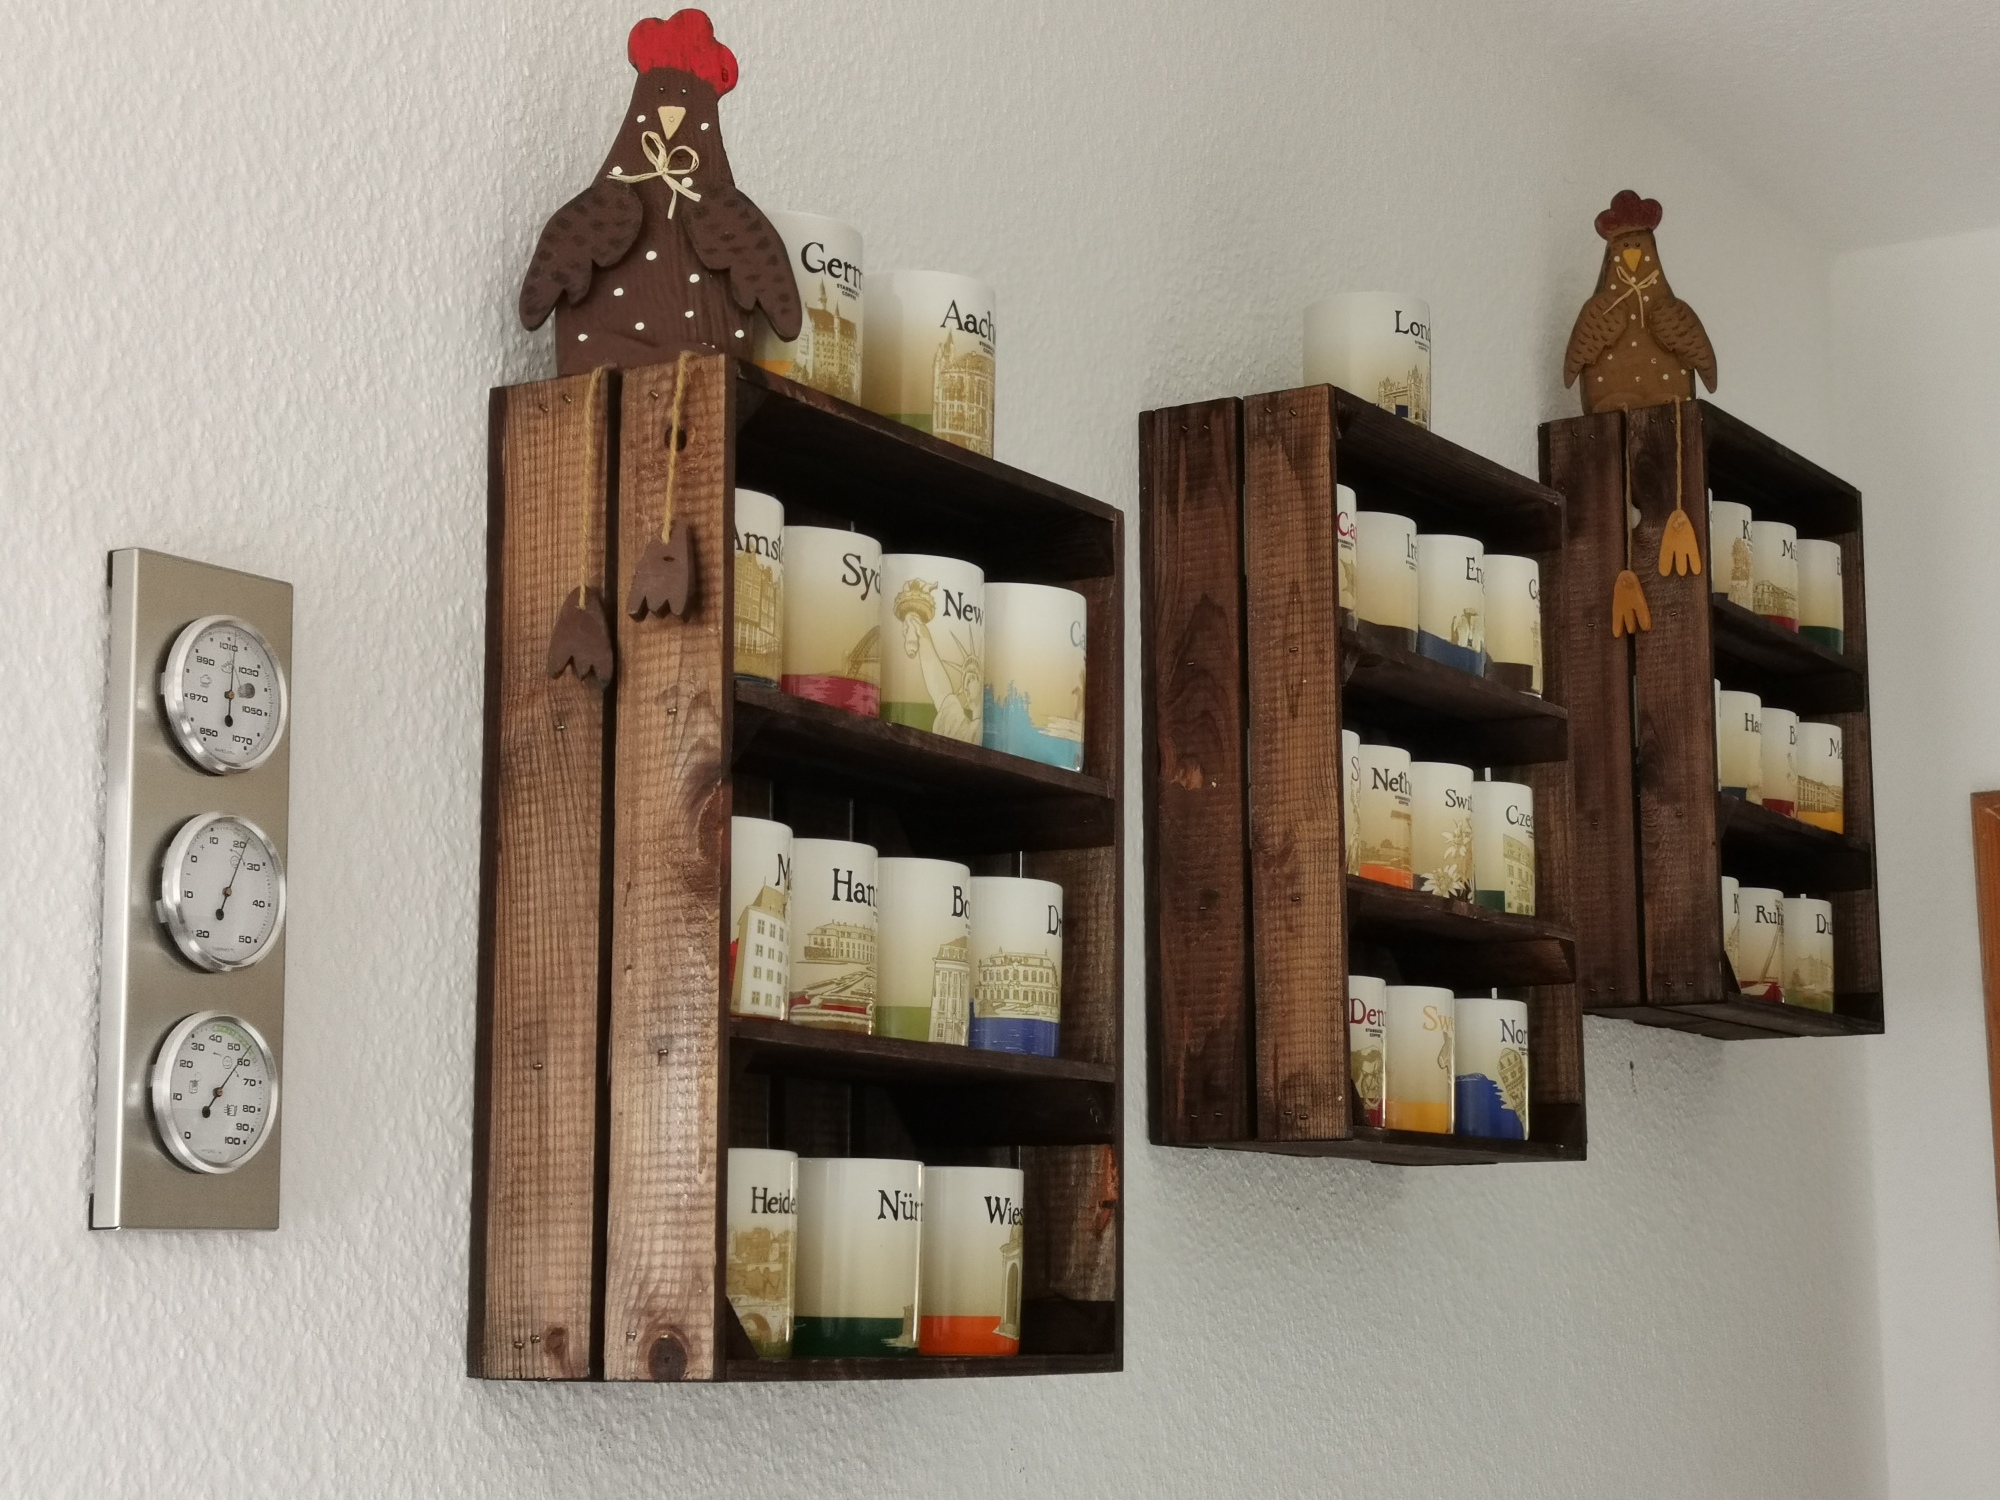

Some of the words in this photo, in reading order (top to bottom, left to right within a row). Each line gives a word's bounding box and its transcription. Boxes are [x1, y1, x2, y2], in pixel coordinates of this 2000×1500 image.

[942, 588, 984, 626] New
[232, 735, 253, 746] 1070
[1371, 767, 1412, 796] Neth
[233, 840, 246, 849] 20
[246, 862, 261, 872] 30
[832, 868, 877, 907] Han
[252, 899, 265, 908] 40
[196, 929, 210, 939] 20
[238, 935, 252, 944] 50
[1349, 998, 1386, 1027] Den
[208, 1034, 222, 1043] 40
[191, 1042, 205, 1051] 30
[179, 1059, 194, 1068] 20
[243, 1078, 257, 1087] 70
[224, 1136, 241, 1145] 100
[877, 1189, 924, 1222] Nür
